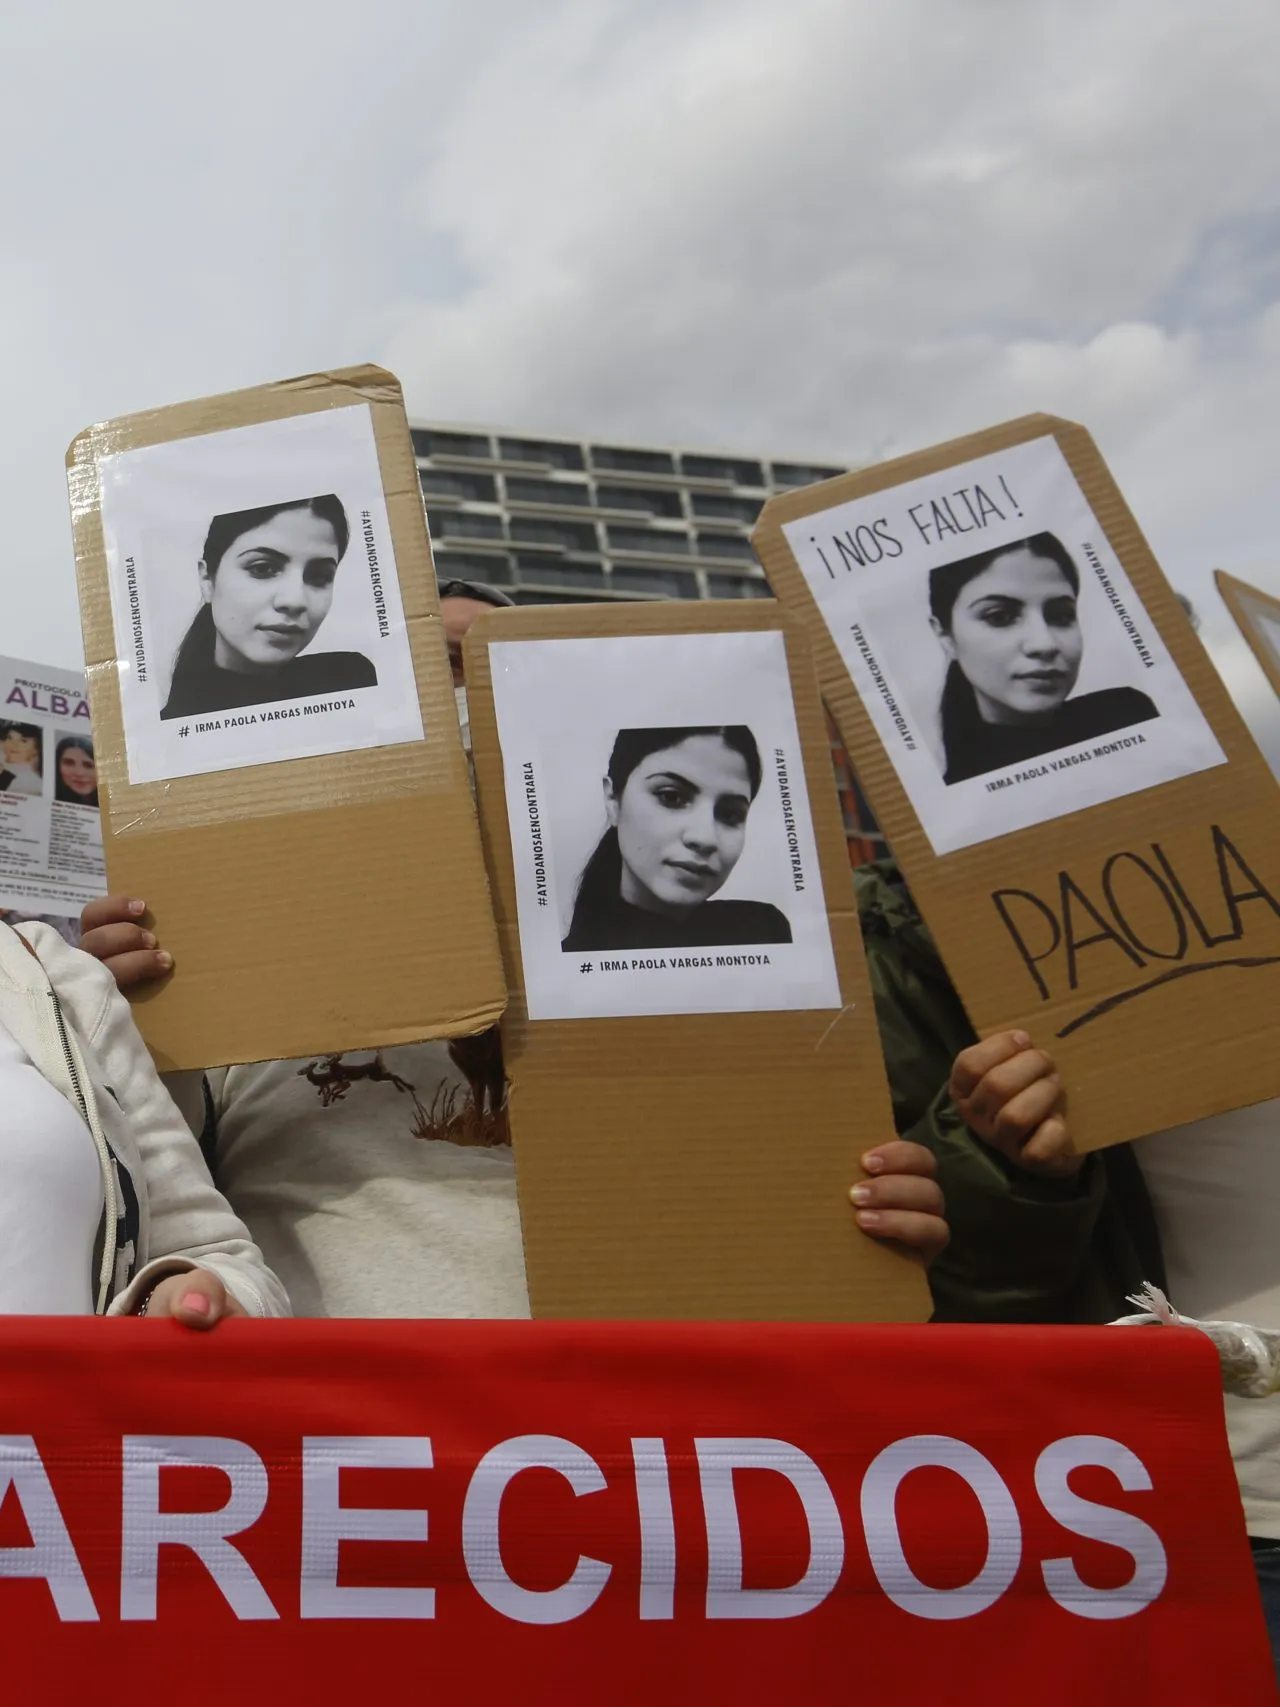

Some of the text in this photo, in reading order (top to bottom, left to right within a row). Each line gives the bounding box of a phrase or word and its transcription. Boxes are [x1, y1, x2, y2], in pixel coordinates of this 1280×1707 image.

[125, 556, 147, 683] #AYUDANOSAENCONTRARLA
[361, 510, 390, 638] #AYUDANOSAENCONTRARLA
[1082, 542, 1155, 669] #AYUDANOSAENCONTRARLA
[5, 686, 91, 720] ALBA
[14, 678, 81, 697] PROTOCOLO
[195, 717, 221, 733] IRMA
[224, 715, 256, 728] PAOLA
[260, 708, 300, 722] VARGAS
[304, 699, 355, 716] MONTOYA
[774, 749, 805, 892] #AYUDANOSAENCONTRARLA
[985, 734, 1146, 793] IRMA PAOLA VARGAS MONTOYA
[523, 761, 548, 906] #AYUDANOSAENCONTRARLA
[600, 959, 628, 971] IRMA
[632, 958, 666, 969] PAOLA
[669, 957, 713, 968] VARGAS
[716, 955, 770, 967] MONTOYA
[991, 824, 1280, 1001] PAOLA
